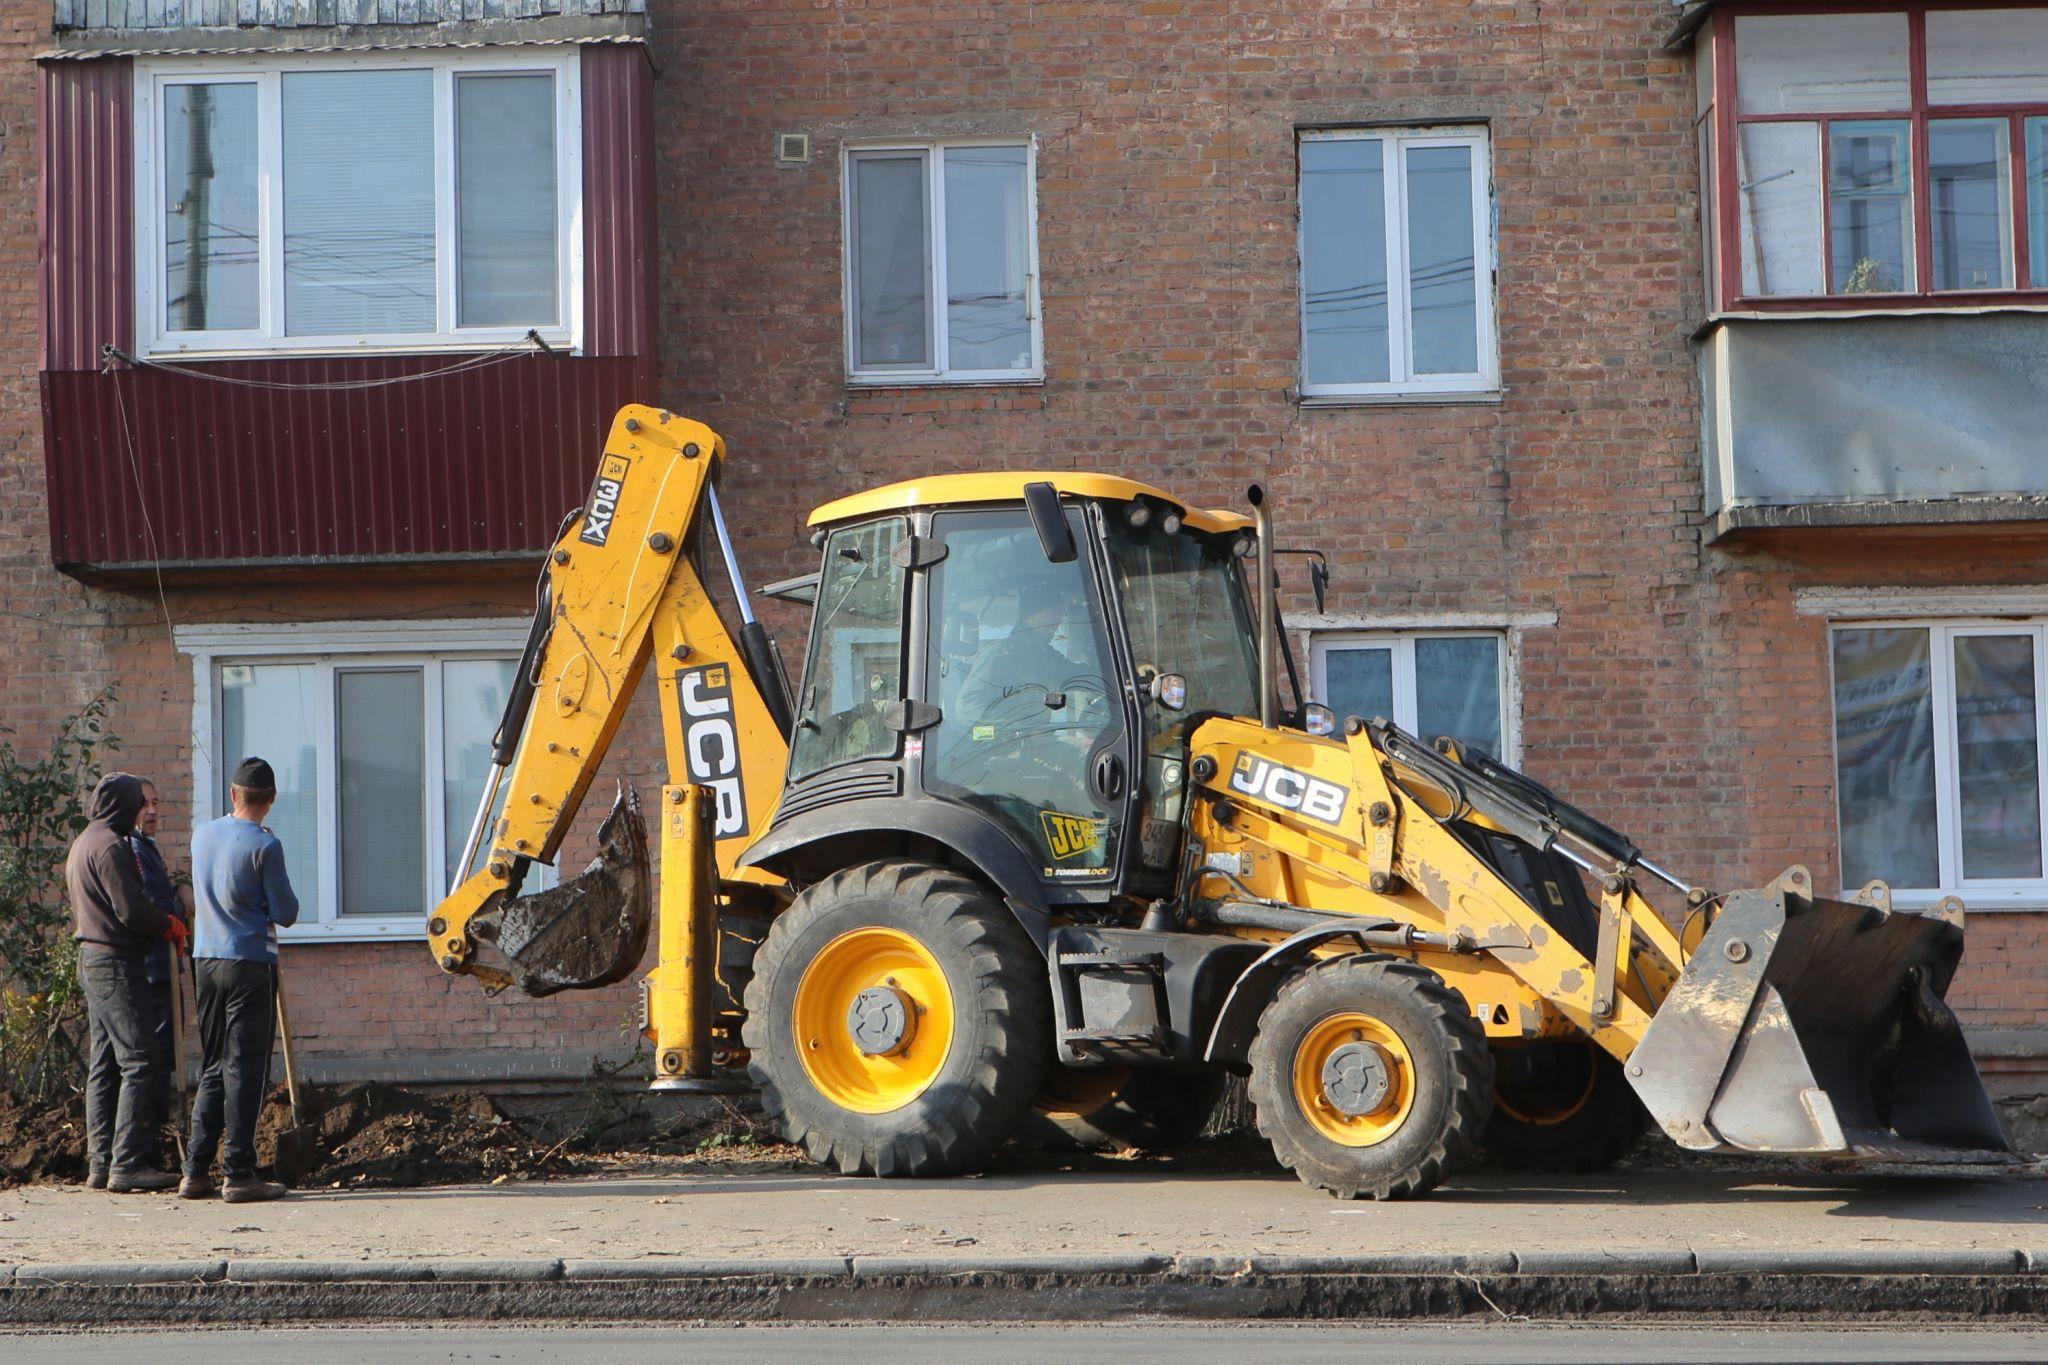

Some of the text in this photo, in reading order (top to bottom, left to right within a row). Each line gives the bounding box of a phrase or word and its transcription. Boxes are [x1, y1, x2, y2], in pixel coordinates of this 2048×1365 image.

[582, 479, 620, 540] 3CX
[681, 671, 744, 836] JCB
[1232, 761, 1344, 822] JCB
[1051, 816, 1098, 854] JCB
